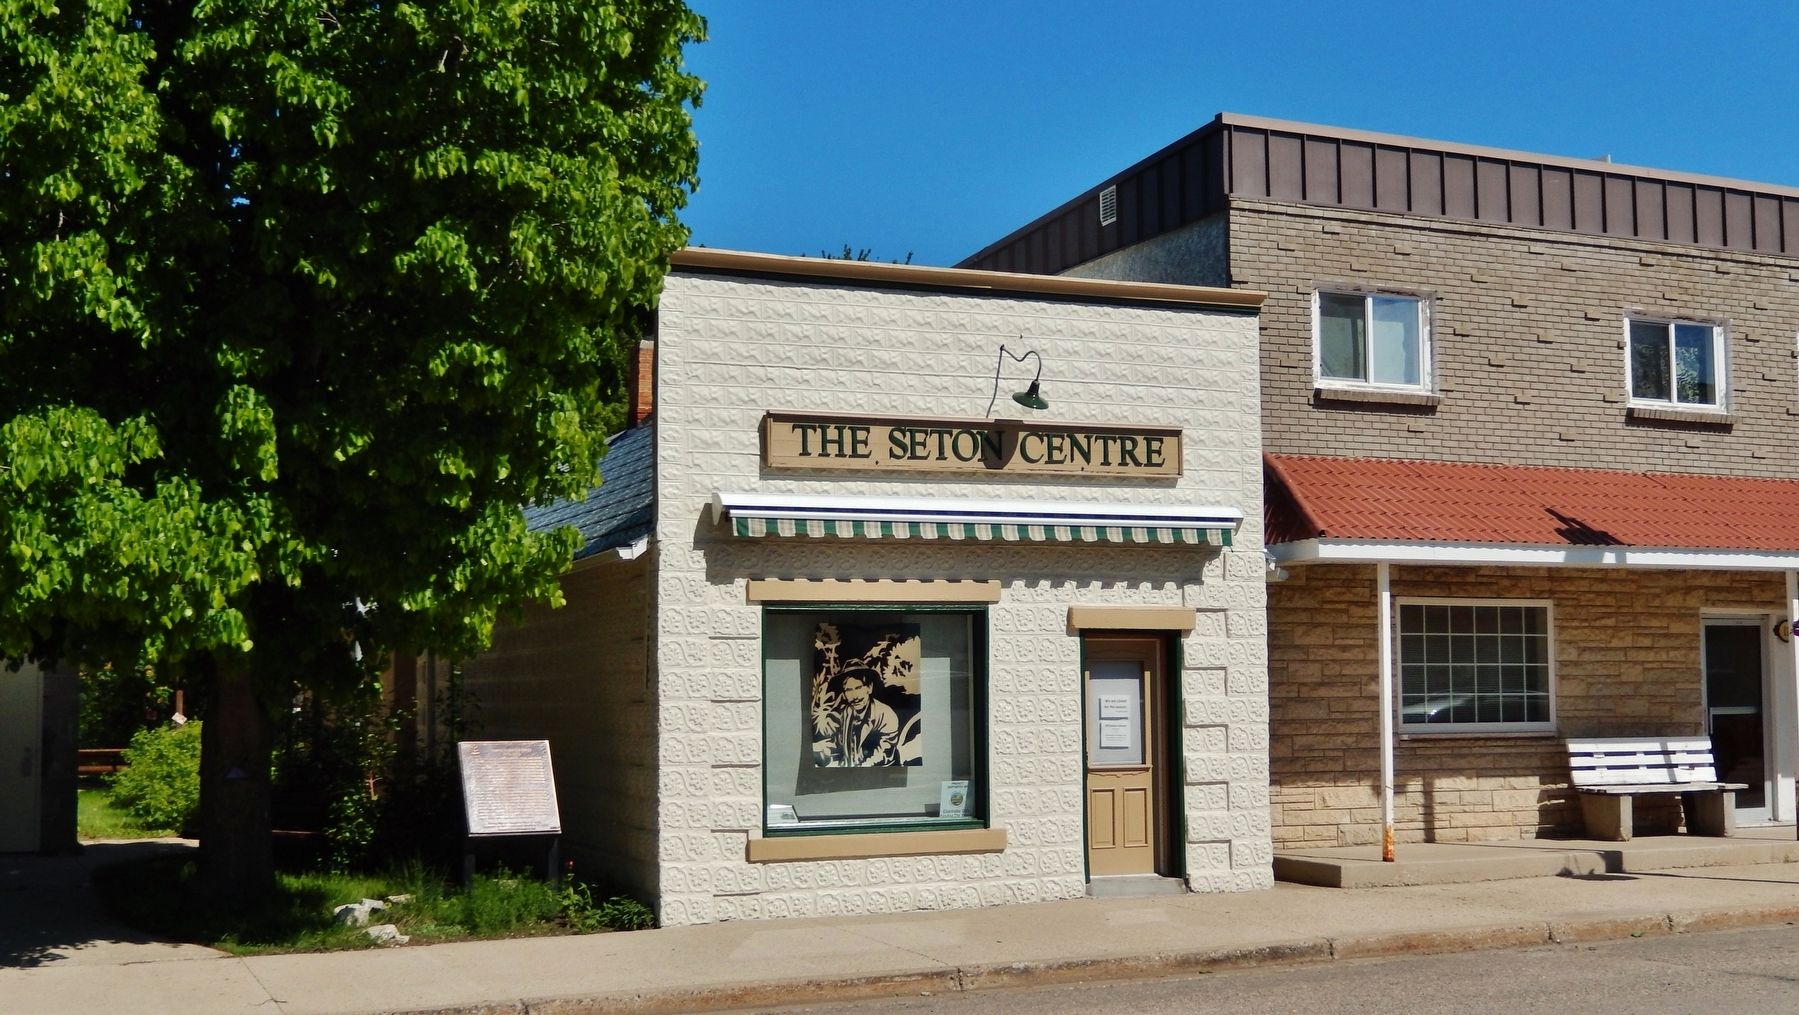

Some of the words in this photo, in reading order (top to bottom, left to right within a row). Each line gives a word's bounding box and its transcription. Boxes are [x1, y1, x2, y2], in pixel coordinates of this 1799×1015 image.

[792, 423, 872, 458] THE
[888, 426, 1005, 463] SETON
[1019, 431, 1166, 468] CENTRE
